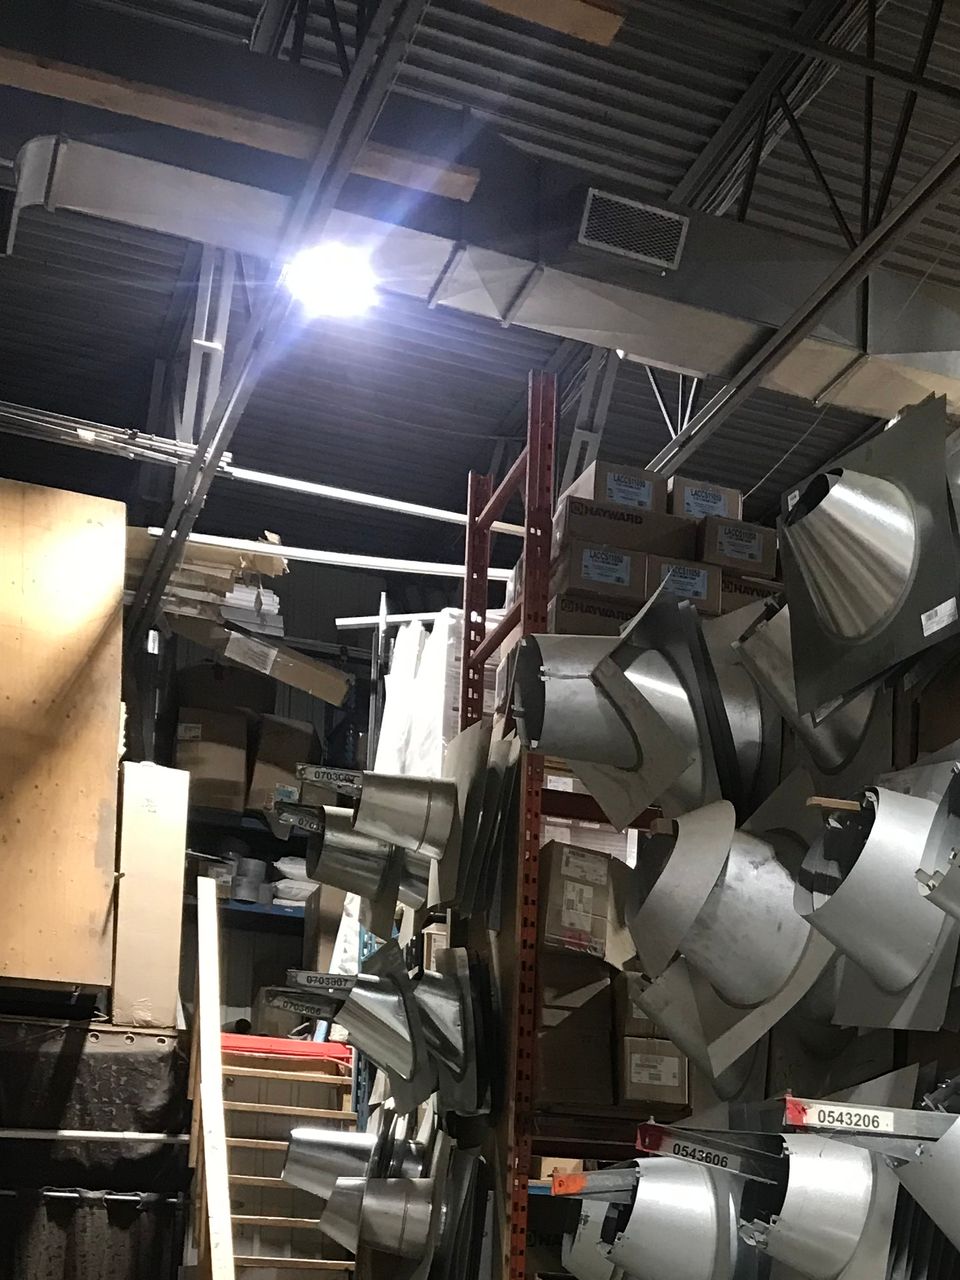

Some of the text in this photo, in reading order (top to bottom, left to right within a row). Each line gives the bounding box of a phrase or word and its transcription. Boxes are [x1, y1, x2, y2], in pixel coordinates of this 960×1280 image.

[585, 505, 644, 525] HAYWARD
[817, 1109, 880, 1129] 0543206
[672, 1142, 729, 1168] 0543606
